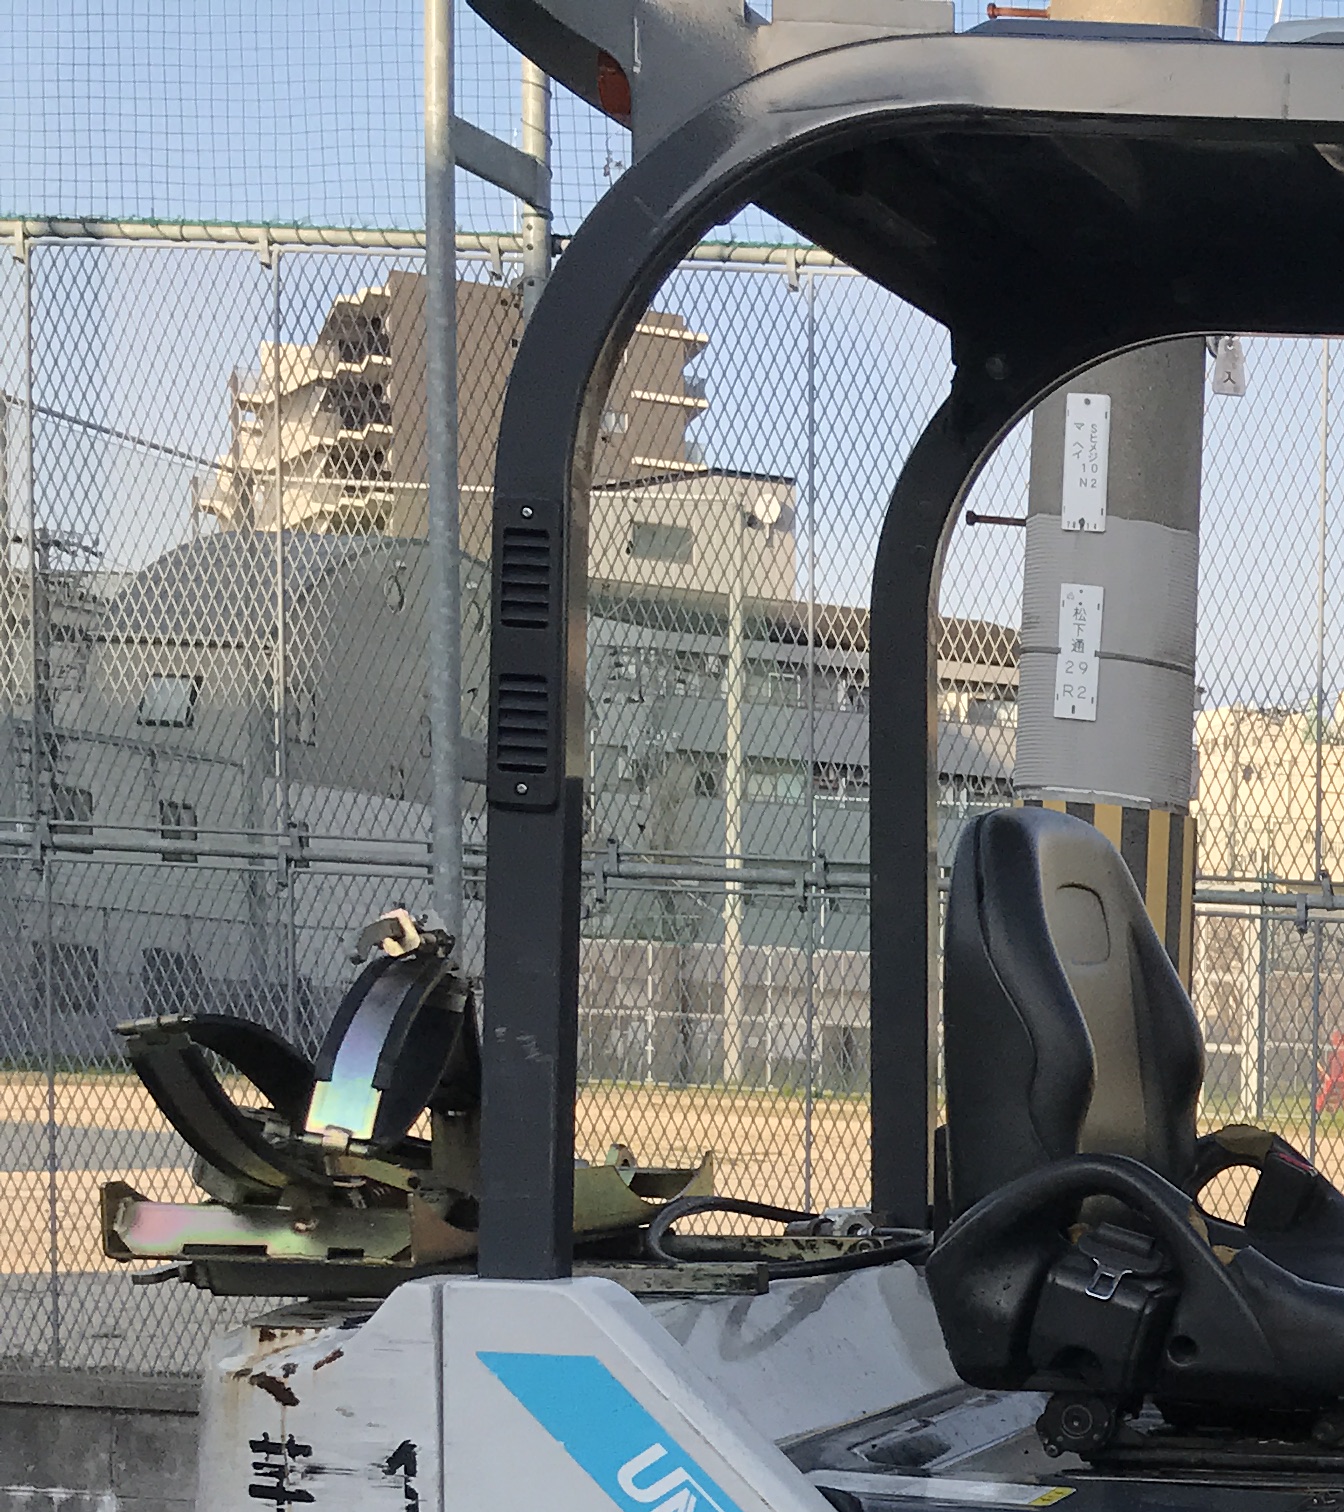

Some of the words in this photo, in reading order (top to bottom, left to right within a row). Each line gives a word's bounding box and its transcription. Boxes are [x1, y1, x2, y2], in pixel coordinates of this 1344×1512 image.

[1079, 477, 1098, 489] N2
[1070, 606, 1088, 654] 松下通
[1064, 660, 1089, 675] 29
[1062, 683, 1087, 700] R2
